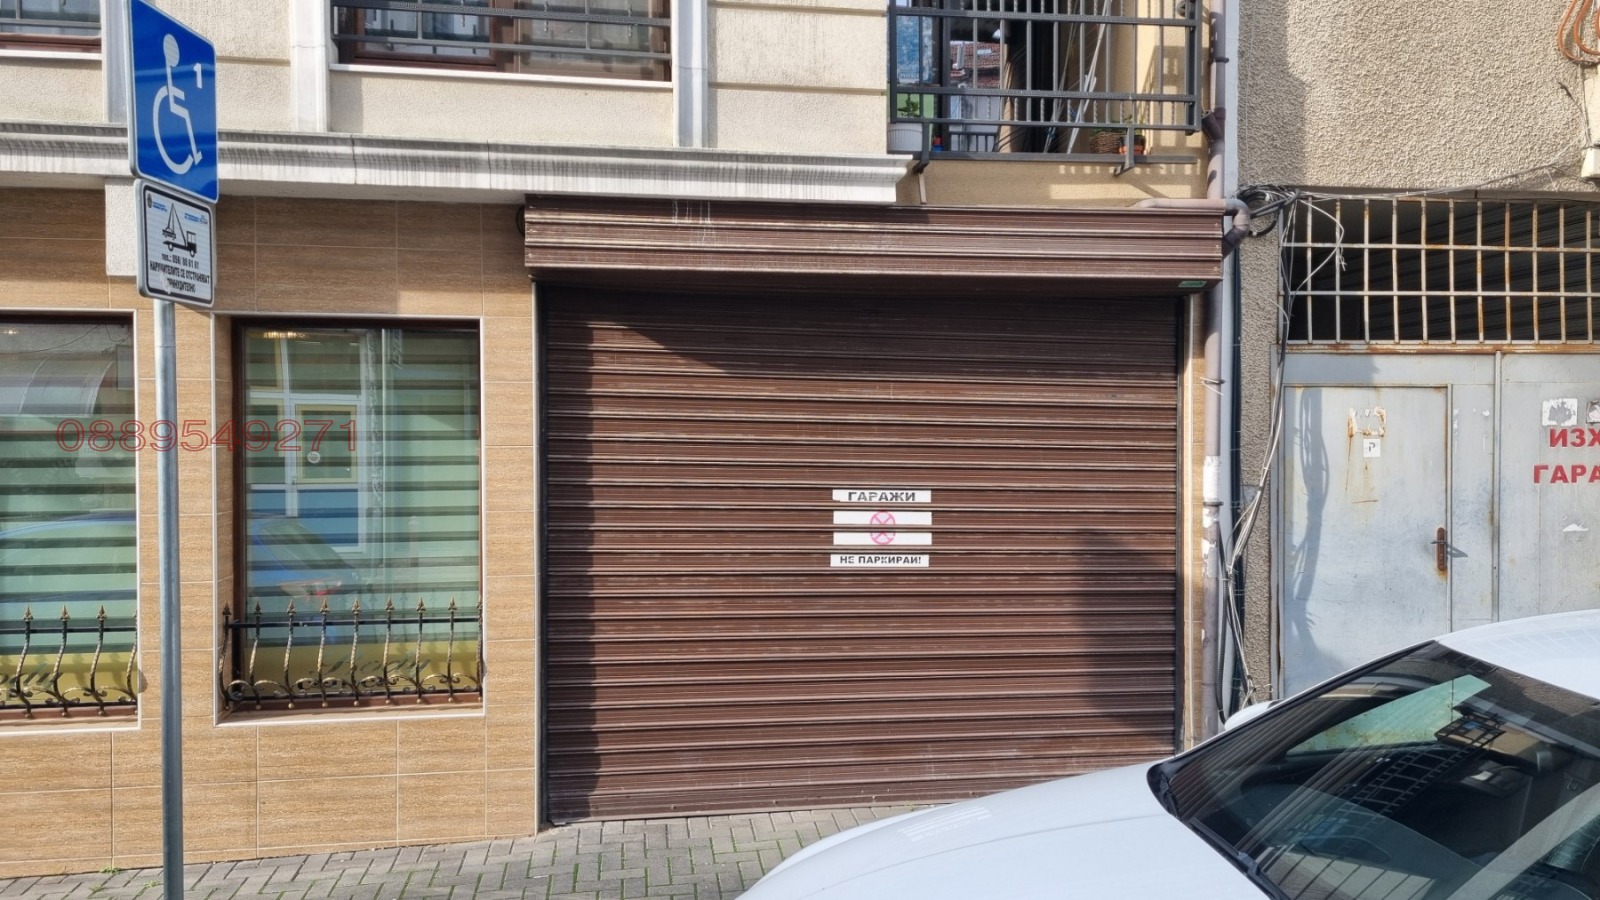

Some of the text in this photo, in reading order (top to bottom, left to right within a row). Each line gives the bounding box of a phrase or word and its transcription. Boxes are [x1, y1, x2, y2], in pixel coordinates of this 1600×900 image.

[193, 62, 203, 89] 1
[848, 491, 916, 502] ГАРАЖИ
[840, 556, 855, 564] НЕ
